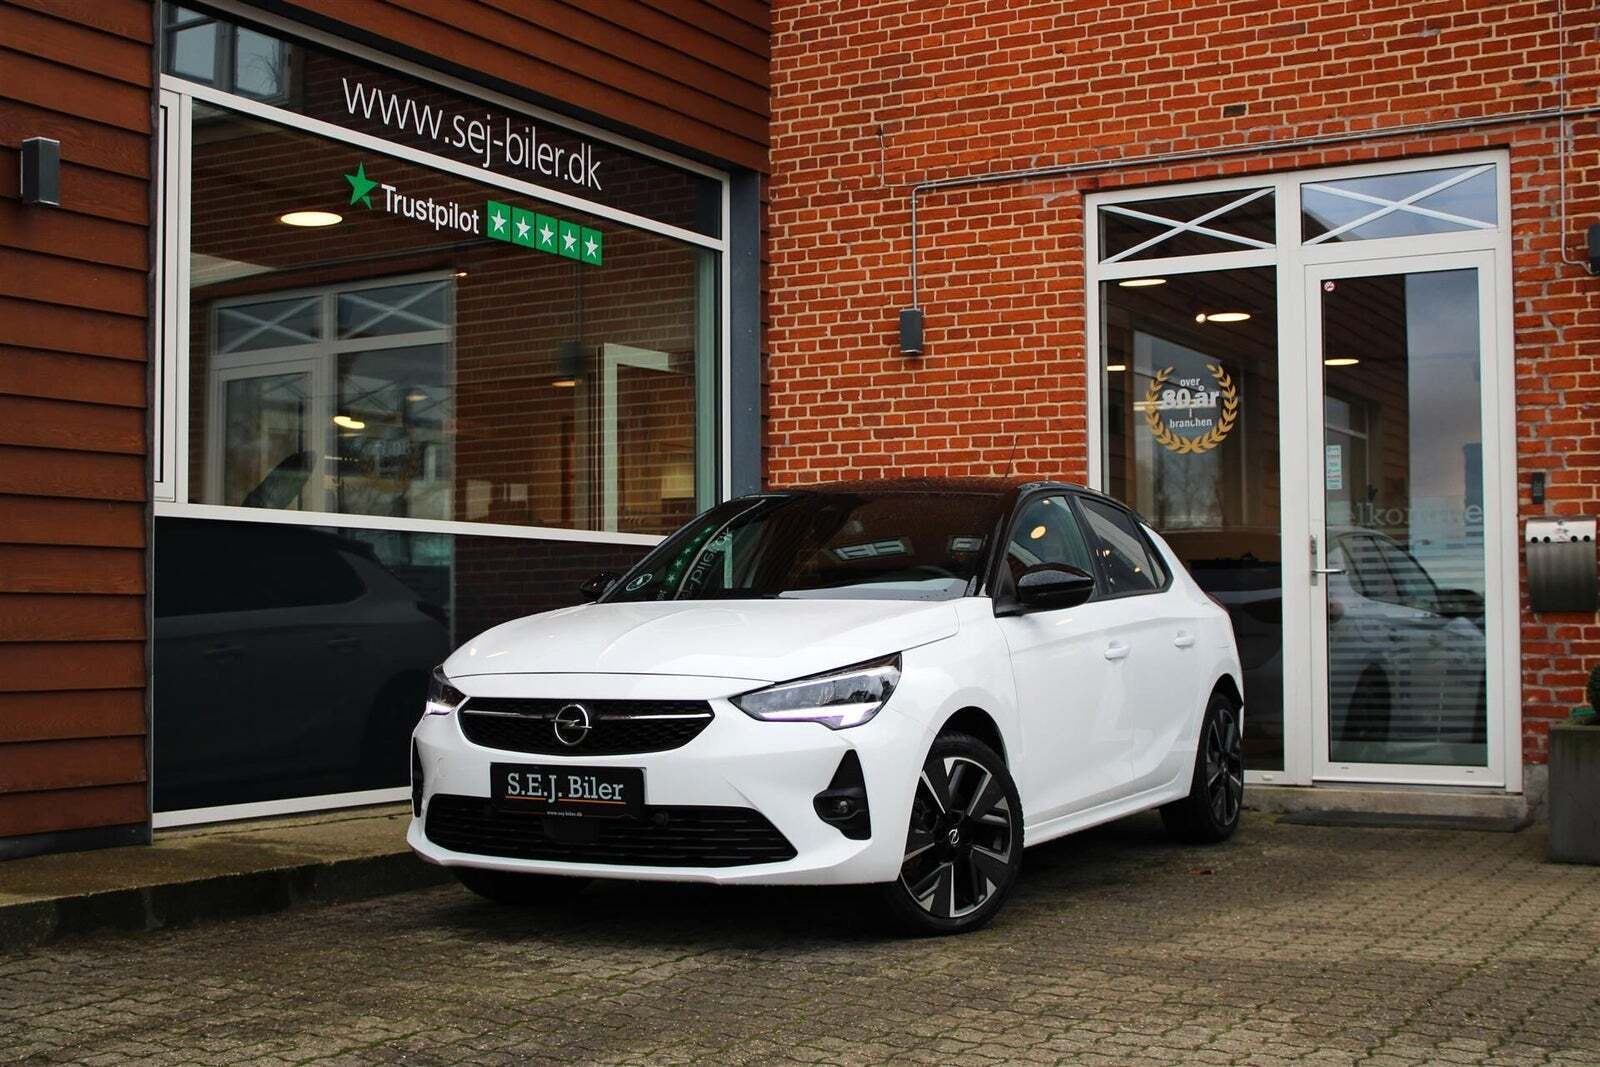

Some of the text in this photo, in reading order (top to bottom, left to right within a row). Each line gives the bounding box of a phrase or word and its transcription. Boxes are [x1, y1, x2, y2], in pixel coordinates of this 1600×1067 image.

[342, 77, 602, 191] www.sej-biler.dk
[381, 184, 480, 234] Trustpilot
[1180, 378, 1201, 387] over
[1162, 385, 1220, 410] 80 år
[1169, 418, 1213, 429] branchen
[507, 772, 624, 803] S.E.J. Biler
